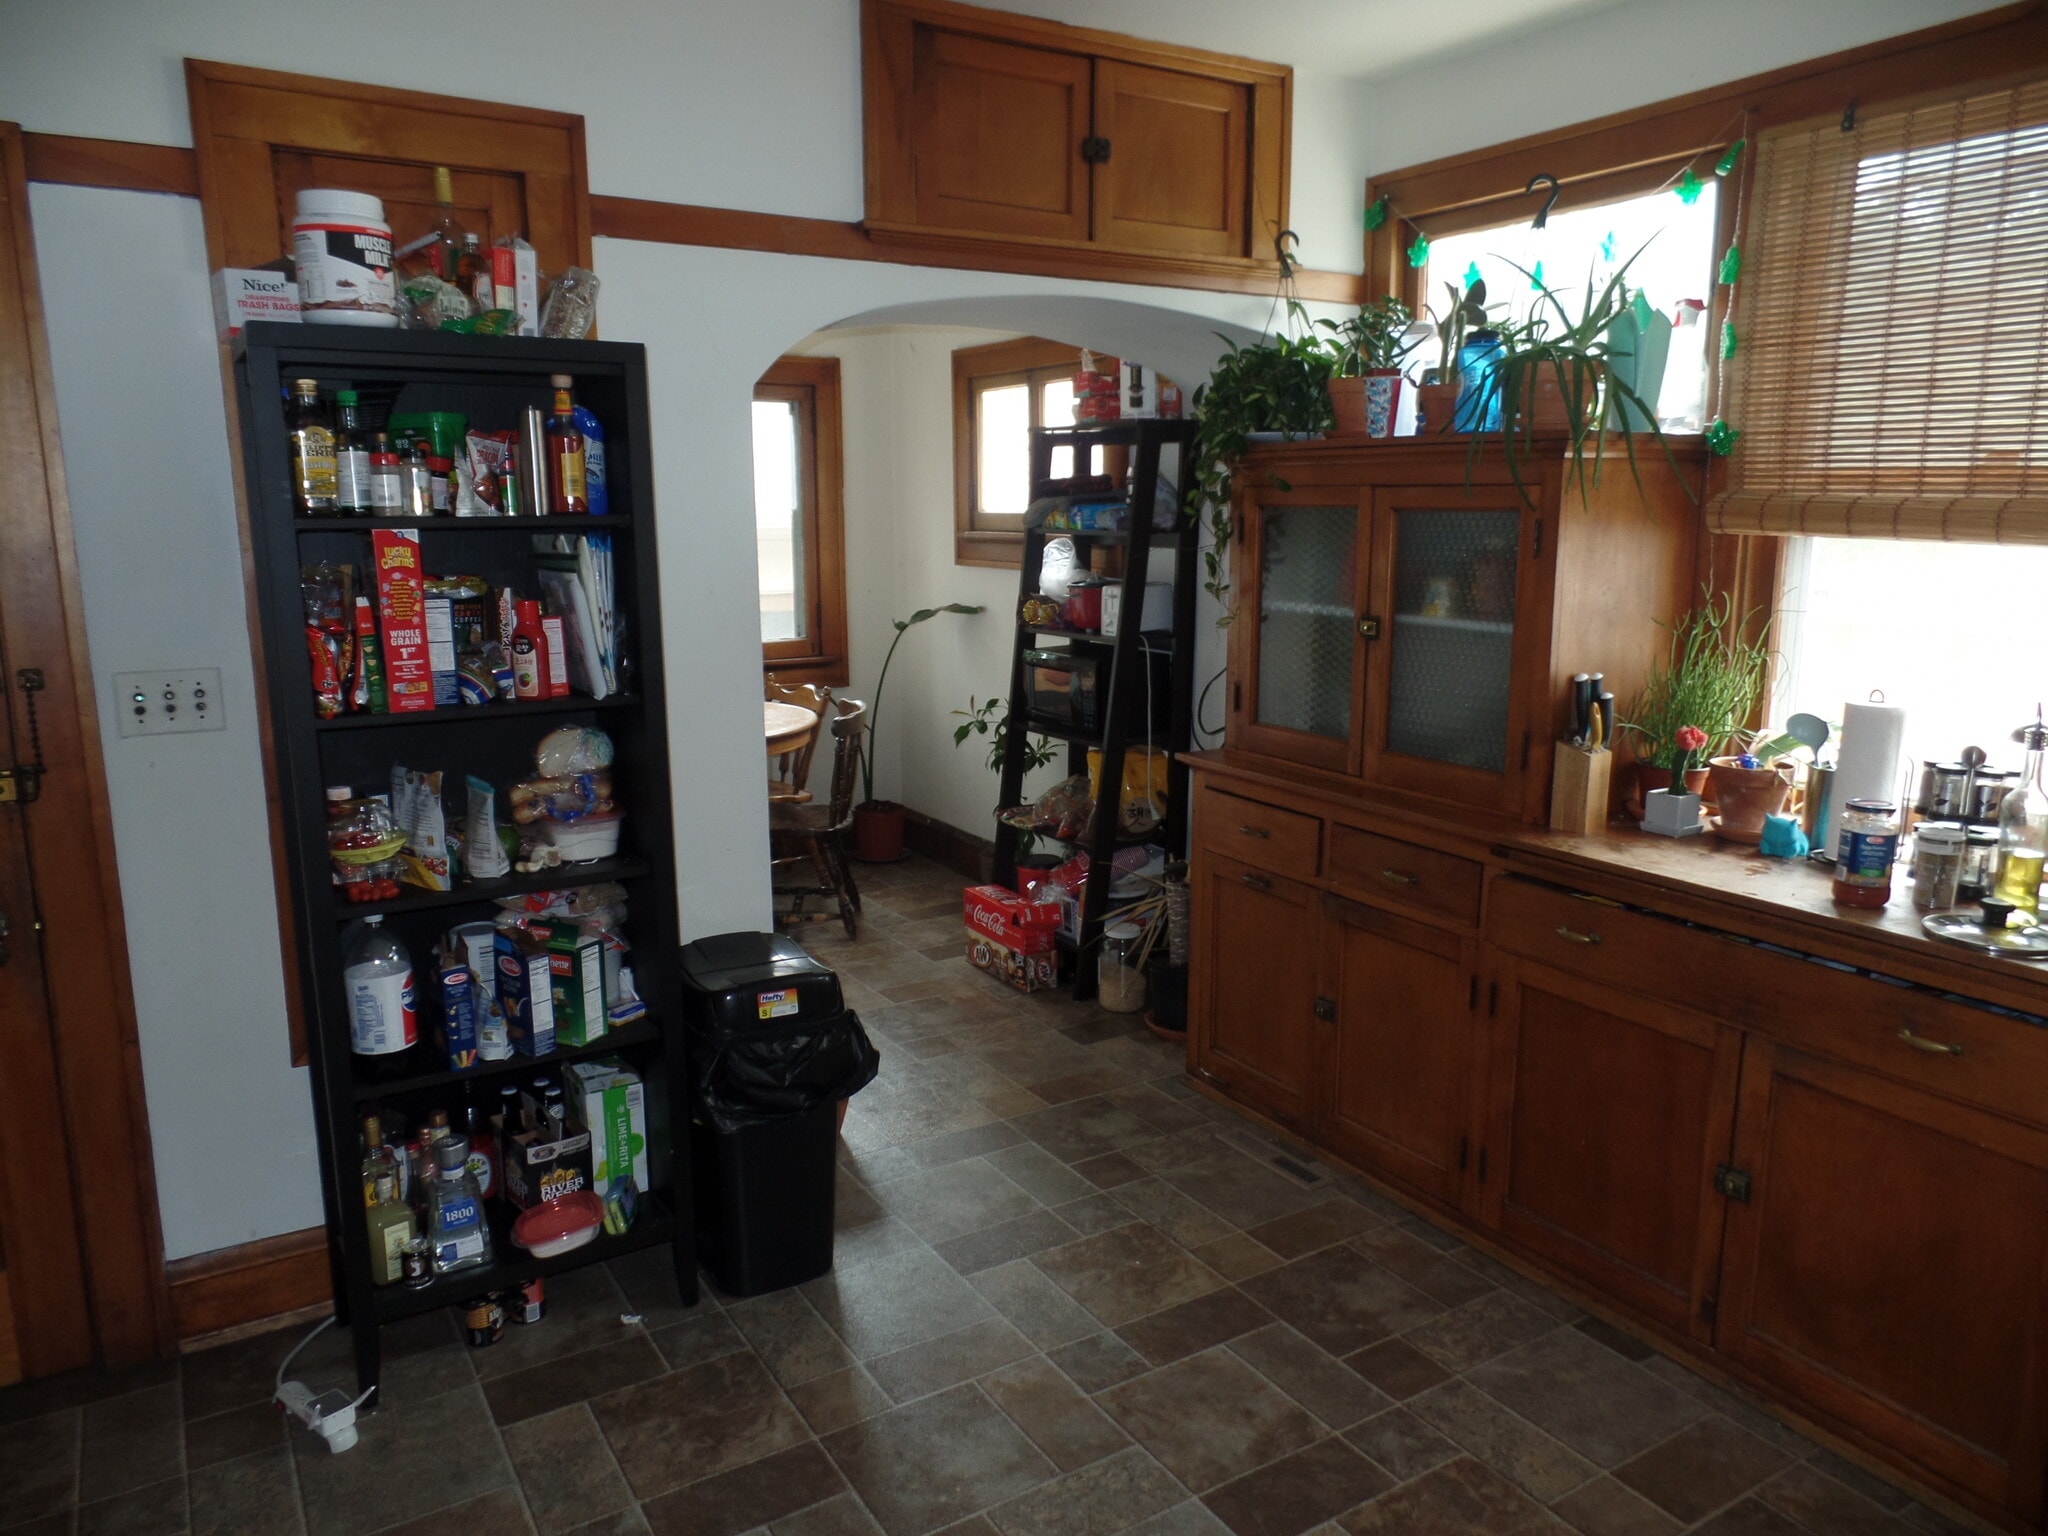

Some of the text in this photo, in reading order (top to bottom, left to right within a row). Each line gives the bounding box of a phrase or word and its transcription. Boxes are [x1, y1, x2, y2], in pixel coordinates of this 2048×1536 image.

[354, 234, 391, 254] MUSCLE
[364, 250, 390, 267] MILK
[242, 279, 284, 292] Nice!
[237, 300, 299, 311] TRASH BAGS
[384, 546, 411, 559] Lucky
[381, 556, 414, 570] Charms
[389, 629, 420, 638] WHOLE
[391, 637, 421, 646] GRAIN
[400, 647, 416, 659] 1ST
[974, 904, 1006, 936] Coca-Cola
[761, 993, 783, 1002] Hefty
[541, 1177, 585, 1195] RIVER
[445, 1206, 474, 1222] 1800
